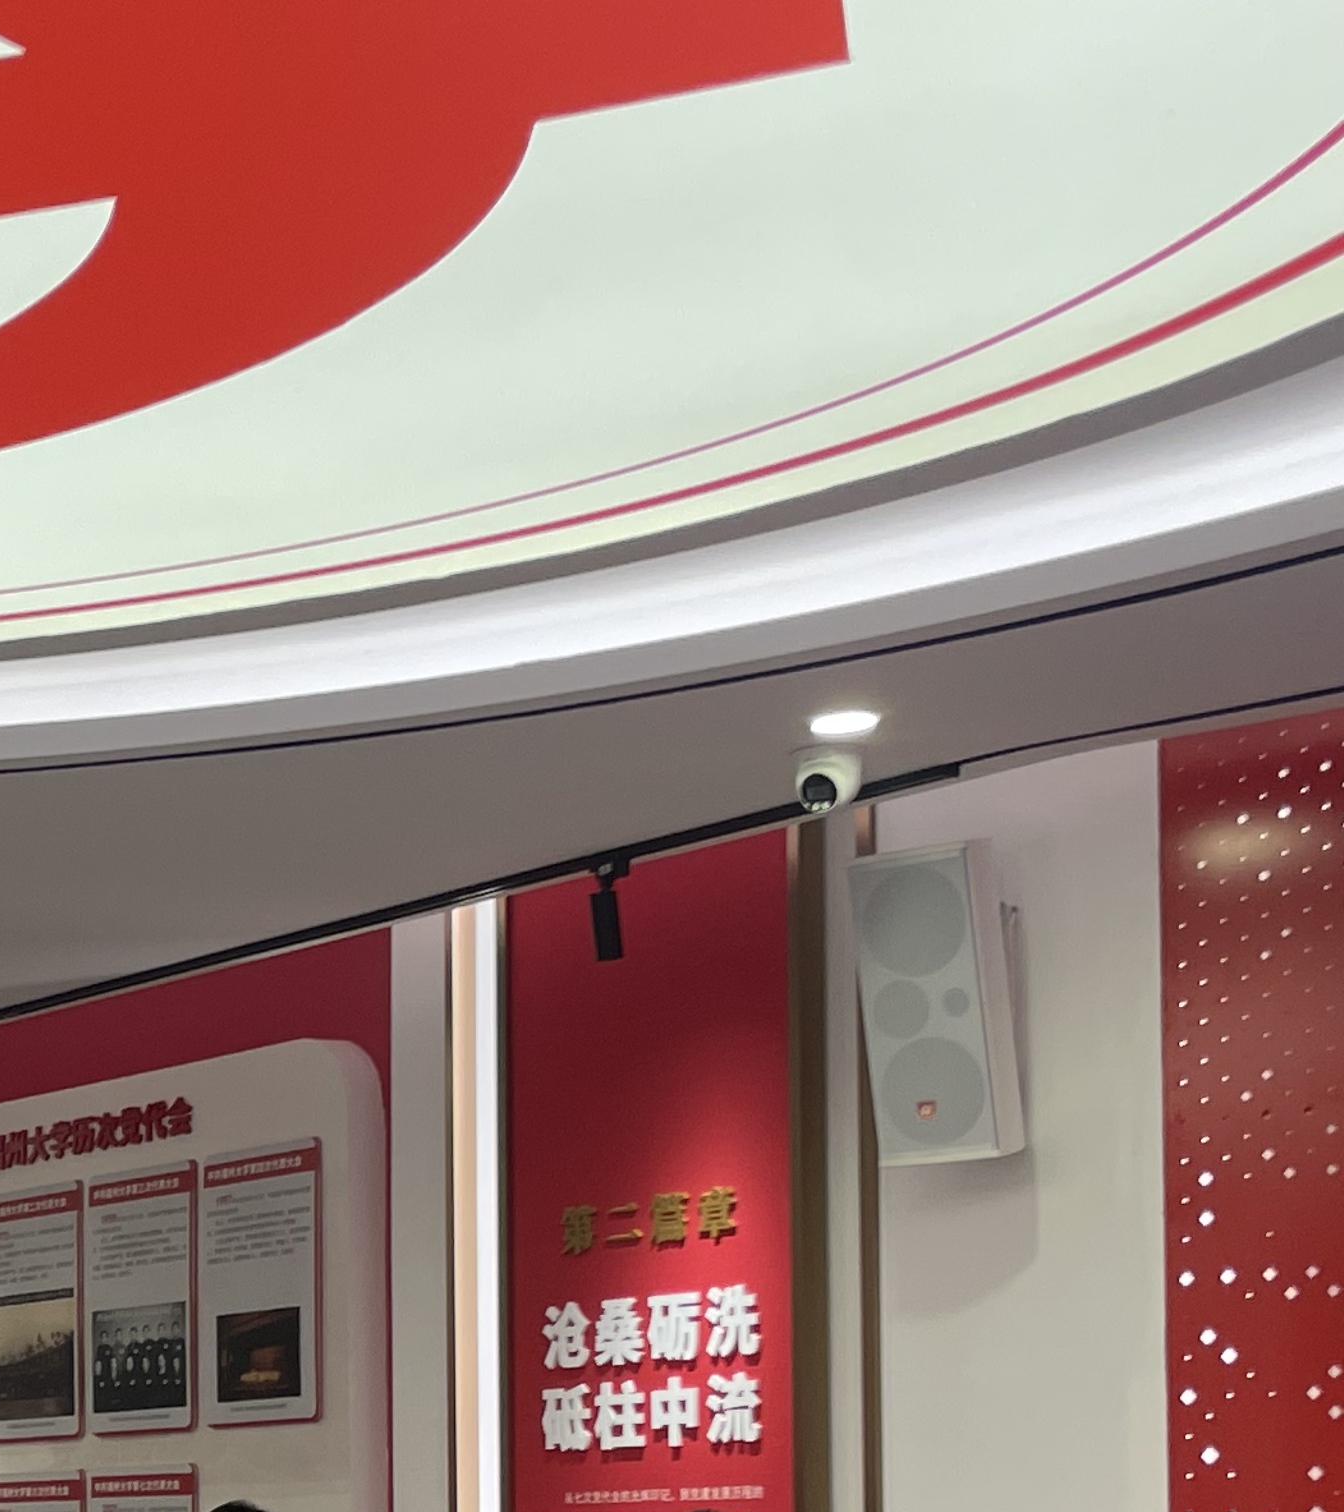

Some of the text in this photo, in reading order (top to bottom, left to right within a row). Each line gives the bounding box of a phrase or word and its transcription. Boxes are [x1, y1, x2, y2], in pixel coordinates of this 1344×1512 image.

[561, 1186, 739, 1256] 第二篇章
[541, 1284, 762, 1371] 沧桑砺洗
[541, 1371, 762, 1455] 砥柱中流
